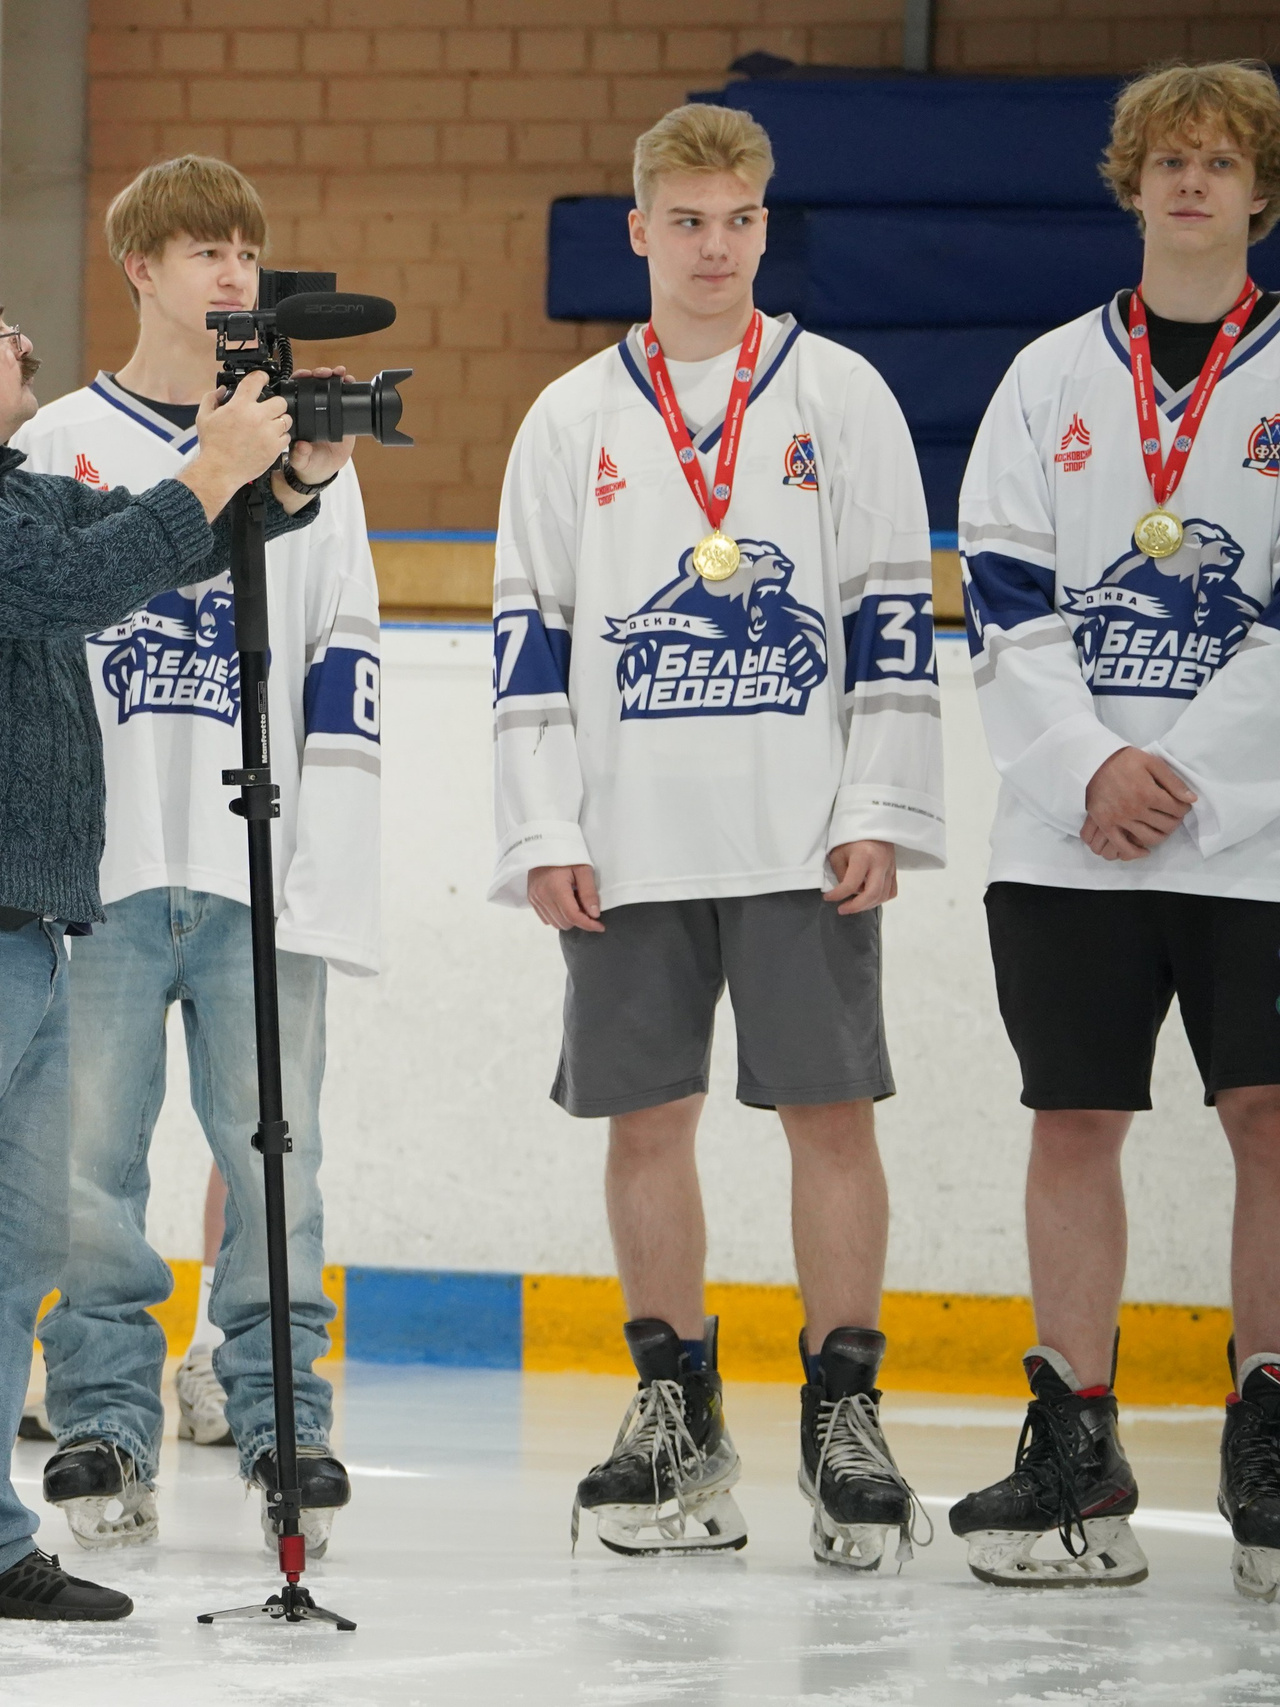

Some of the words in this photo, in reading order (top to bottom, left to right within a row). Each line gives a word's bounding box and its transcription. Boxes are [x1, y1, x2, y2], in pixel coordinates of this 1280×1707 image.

[304, 303, 364, 314] ZOOM
[1063, 461, 1087, 472] СПОРТ
[629, 616, 691, 630] ОСКВА
[493, 615, 529, 700] 7
[655, 643, 788, 679] БЕЛЫЕ
[353, 657, 380, 736] 8
[621, 673, 803, 711] МЕДВЕДИ
[260, 713, 268, 764] Manfrotto
